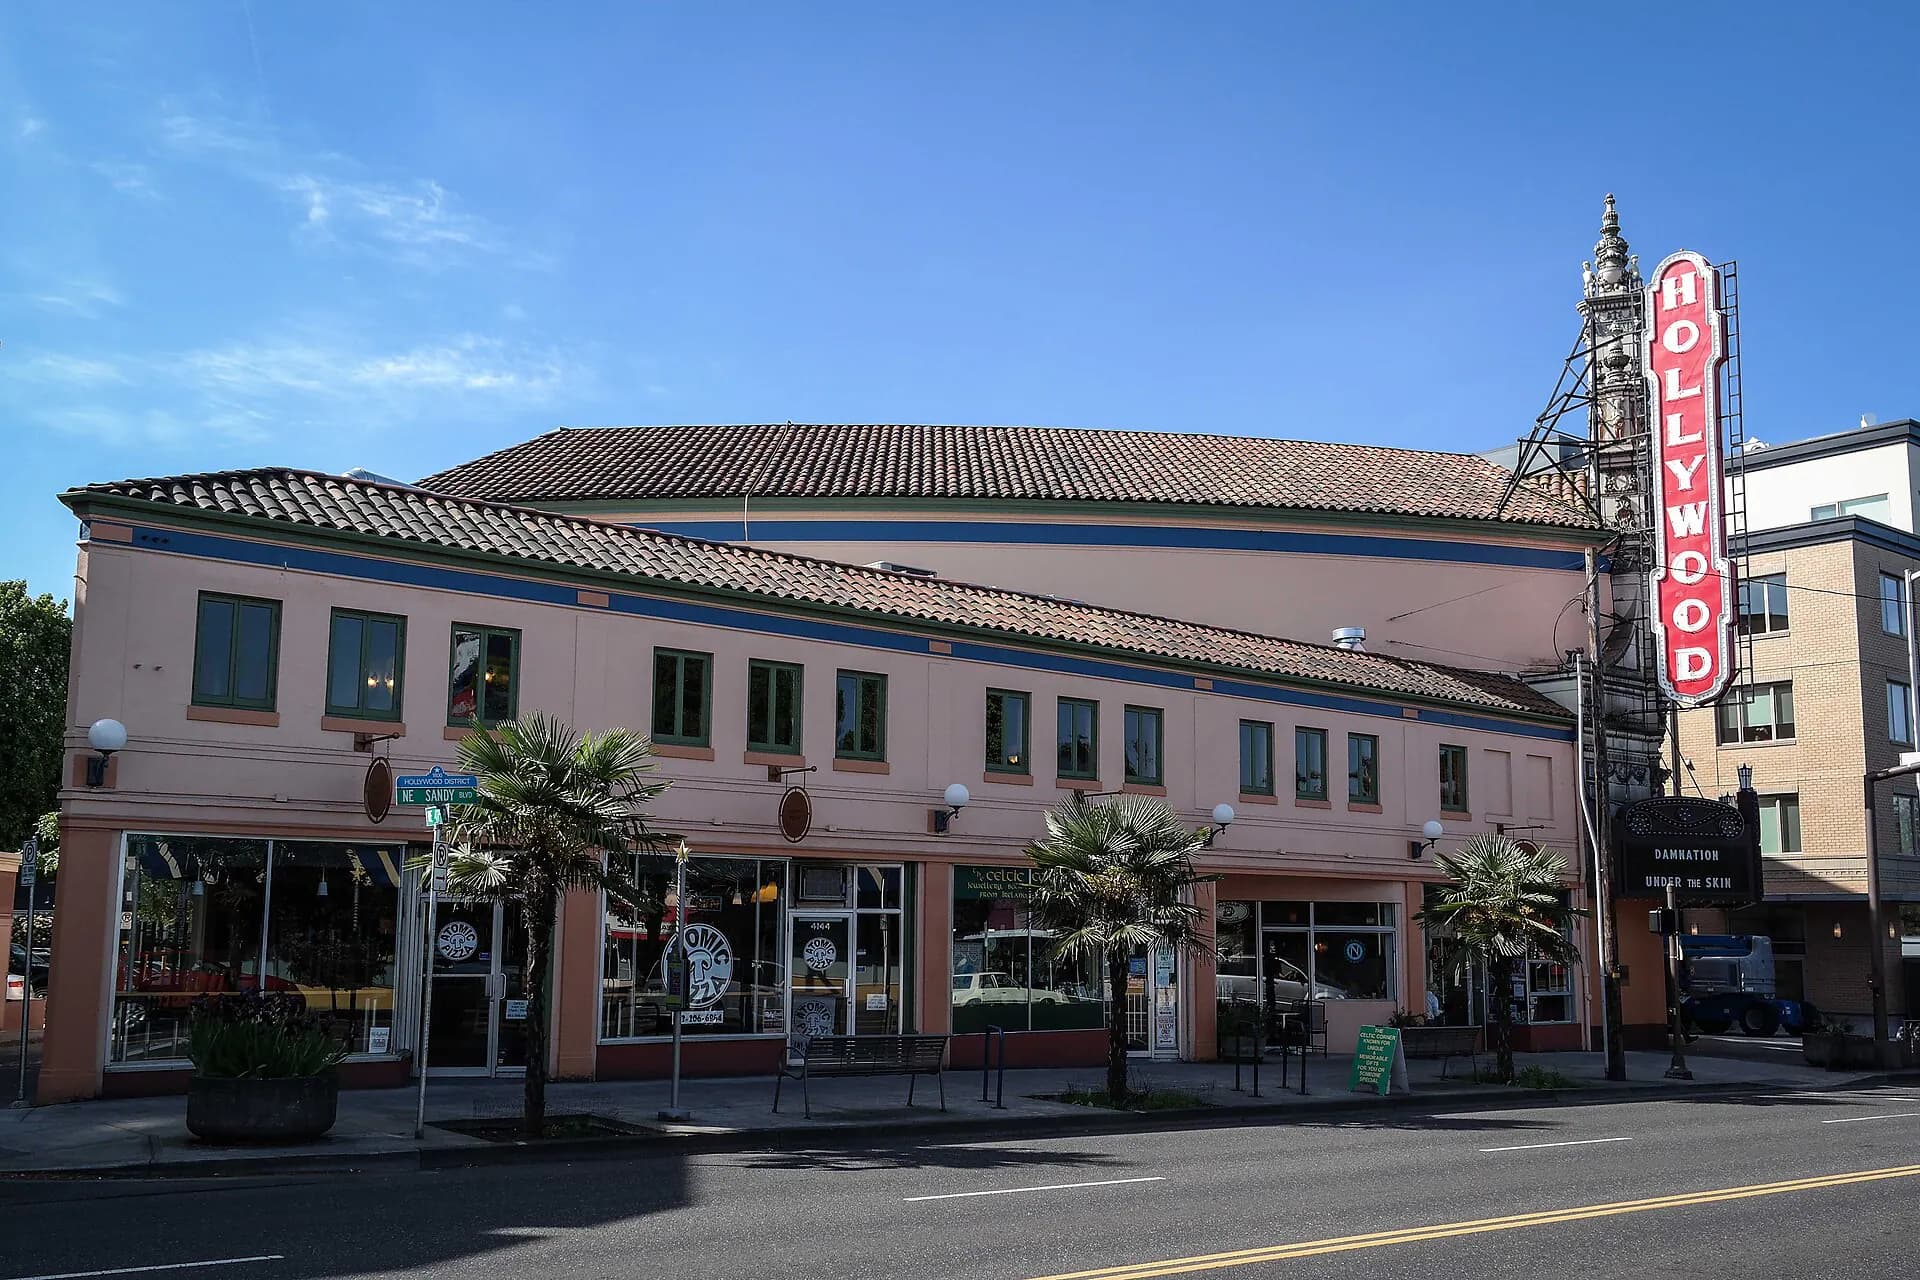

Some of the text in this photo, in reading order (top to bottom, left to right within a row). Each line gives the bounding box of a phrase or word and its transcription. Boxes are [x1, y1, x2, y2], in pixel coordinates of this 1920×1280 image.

[1661, 270, 1714, 683] HOLLYWOOD
[402, 788, 474, 802] NE SANDY BLVD
[1655, 848, 1720, 861] DAMNATION
[1645, 875, 1732, 889] UNDER THE SKIN
[440, 923, 476, 942] ATOMIC
[810, 922, 831, 931] 4144
[441, 944, 474, 959] PIZZA
[684, 927, 730, 966] OMIC
[805, 938, 835, 955] ATOMIC
[806, 957, 833, 970] PIZZA
[796, 1000, 831, 1021] ATOMIC
[1376, 1033, 1396, 1041] CORNER
[1359, 1054, 1389, 1062] MEMORABLE
